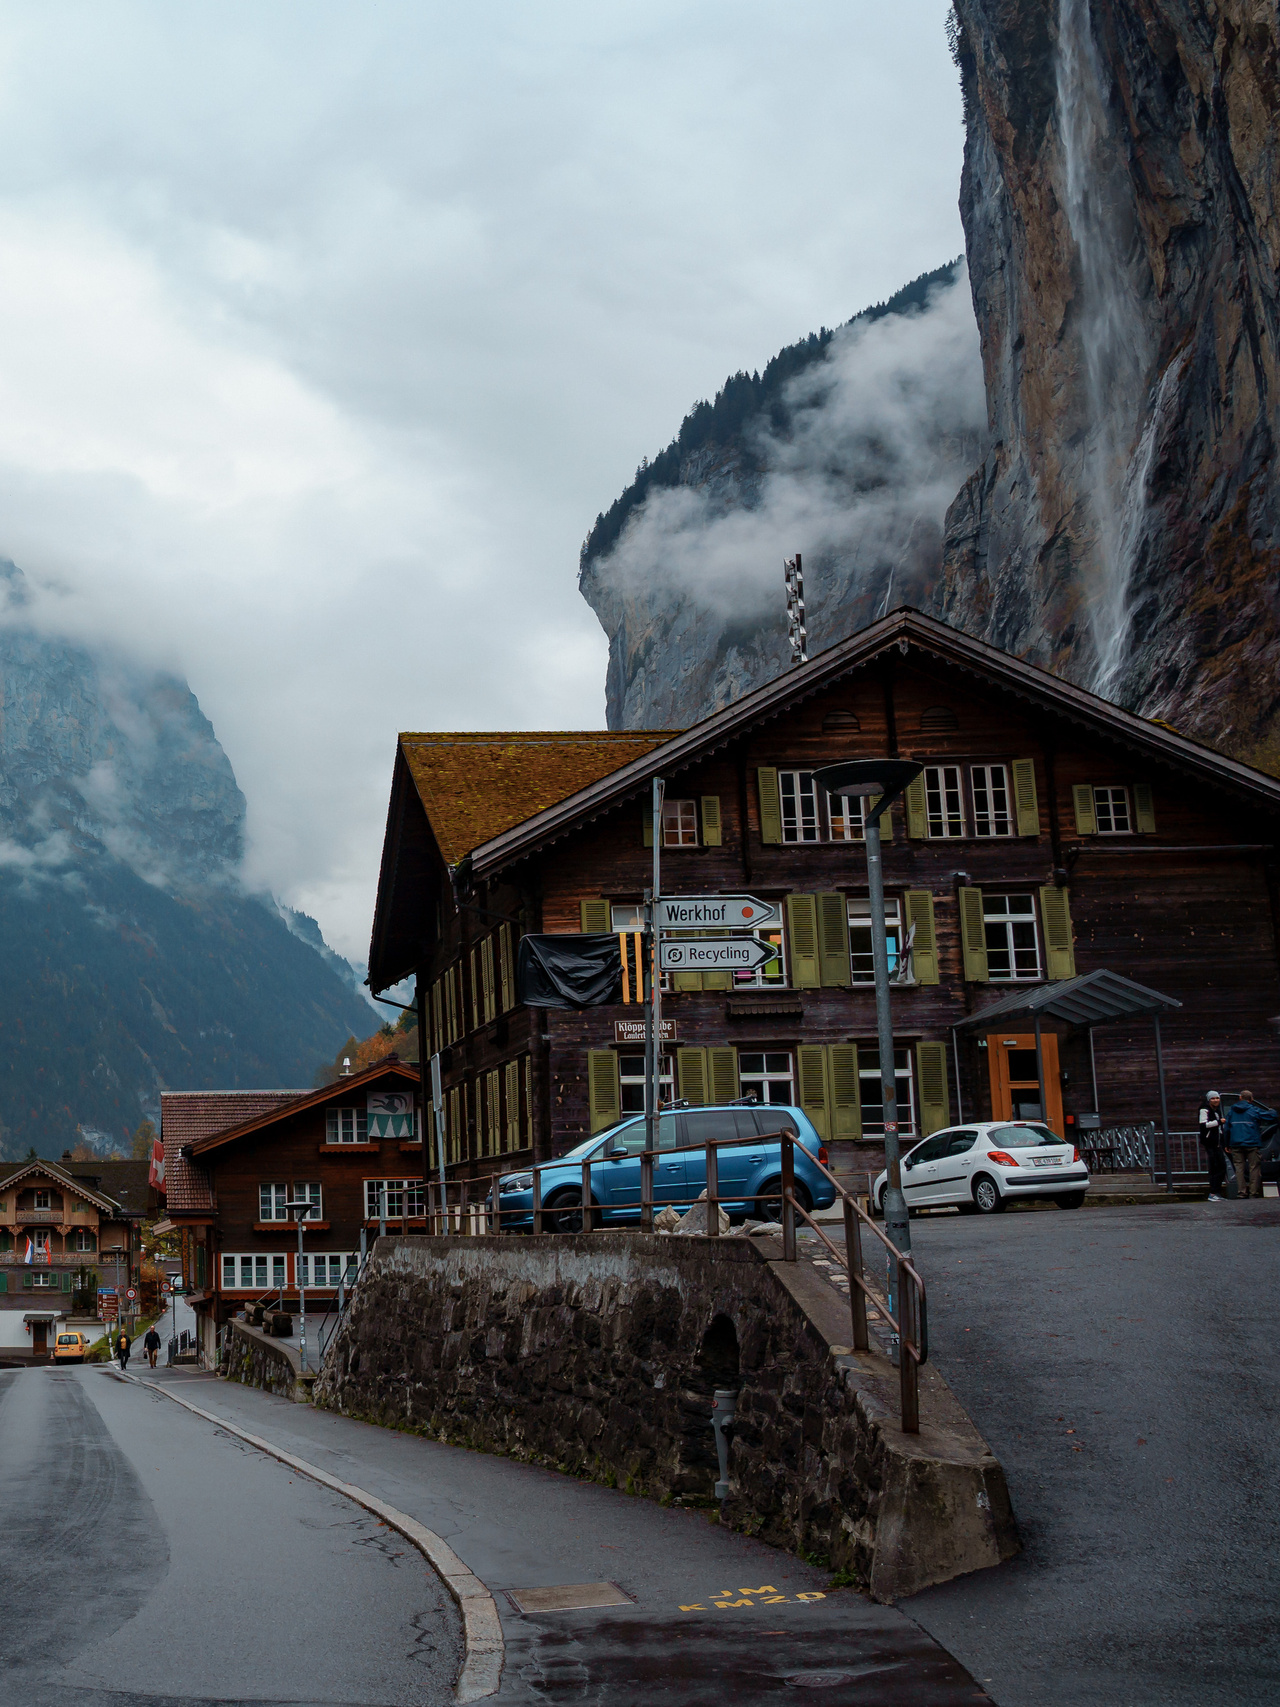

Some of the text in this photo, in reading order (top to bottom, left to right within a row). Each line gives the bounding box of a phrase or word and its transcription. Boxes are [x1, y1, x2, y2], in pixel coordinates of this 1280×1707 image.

[666, 904, 726, 921] Werkhof
[689, 946, 750, 962] Recycling
[708, 1585, 778, 1599] JM
